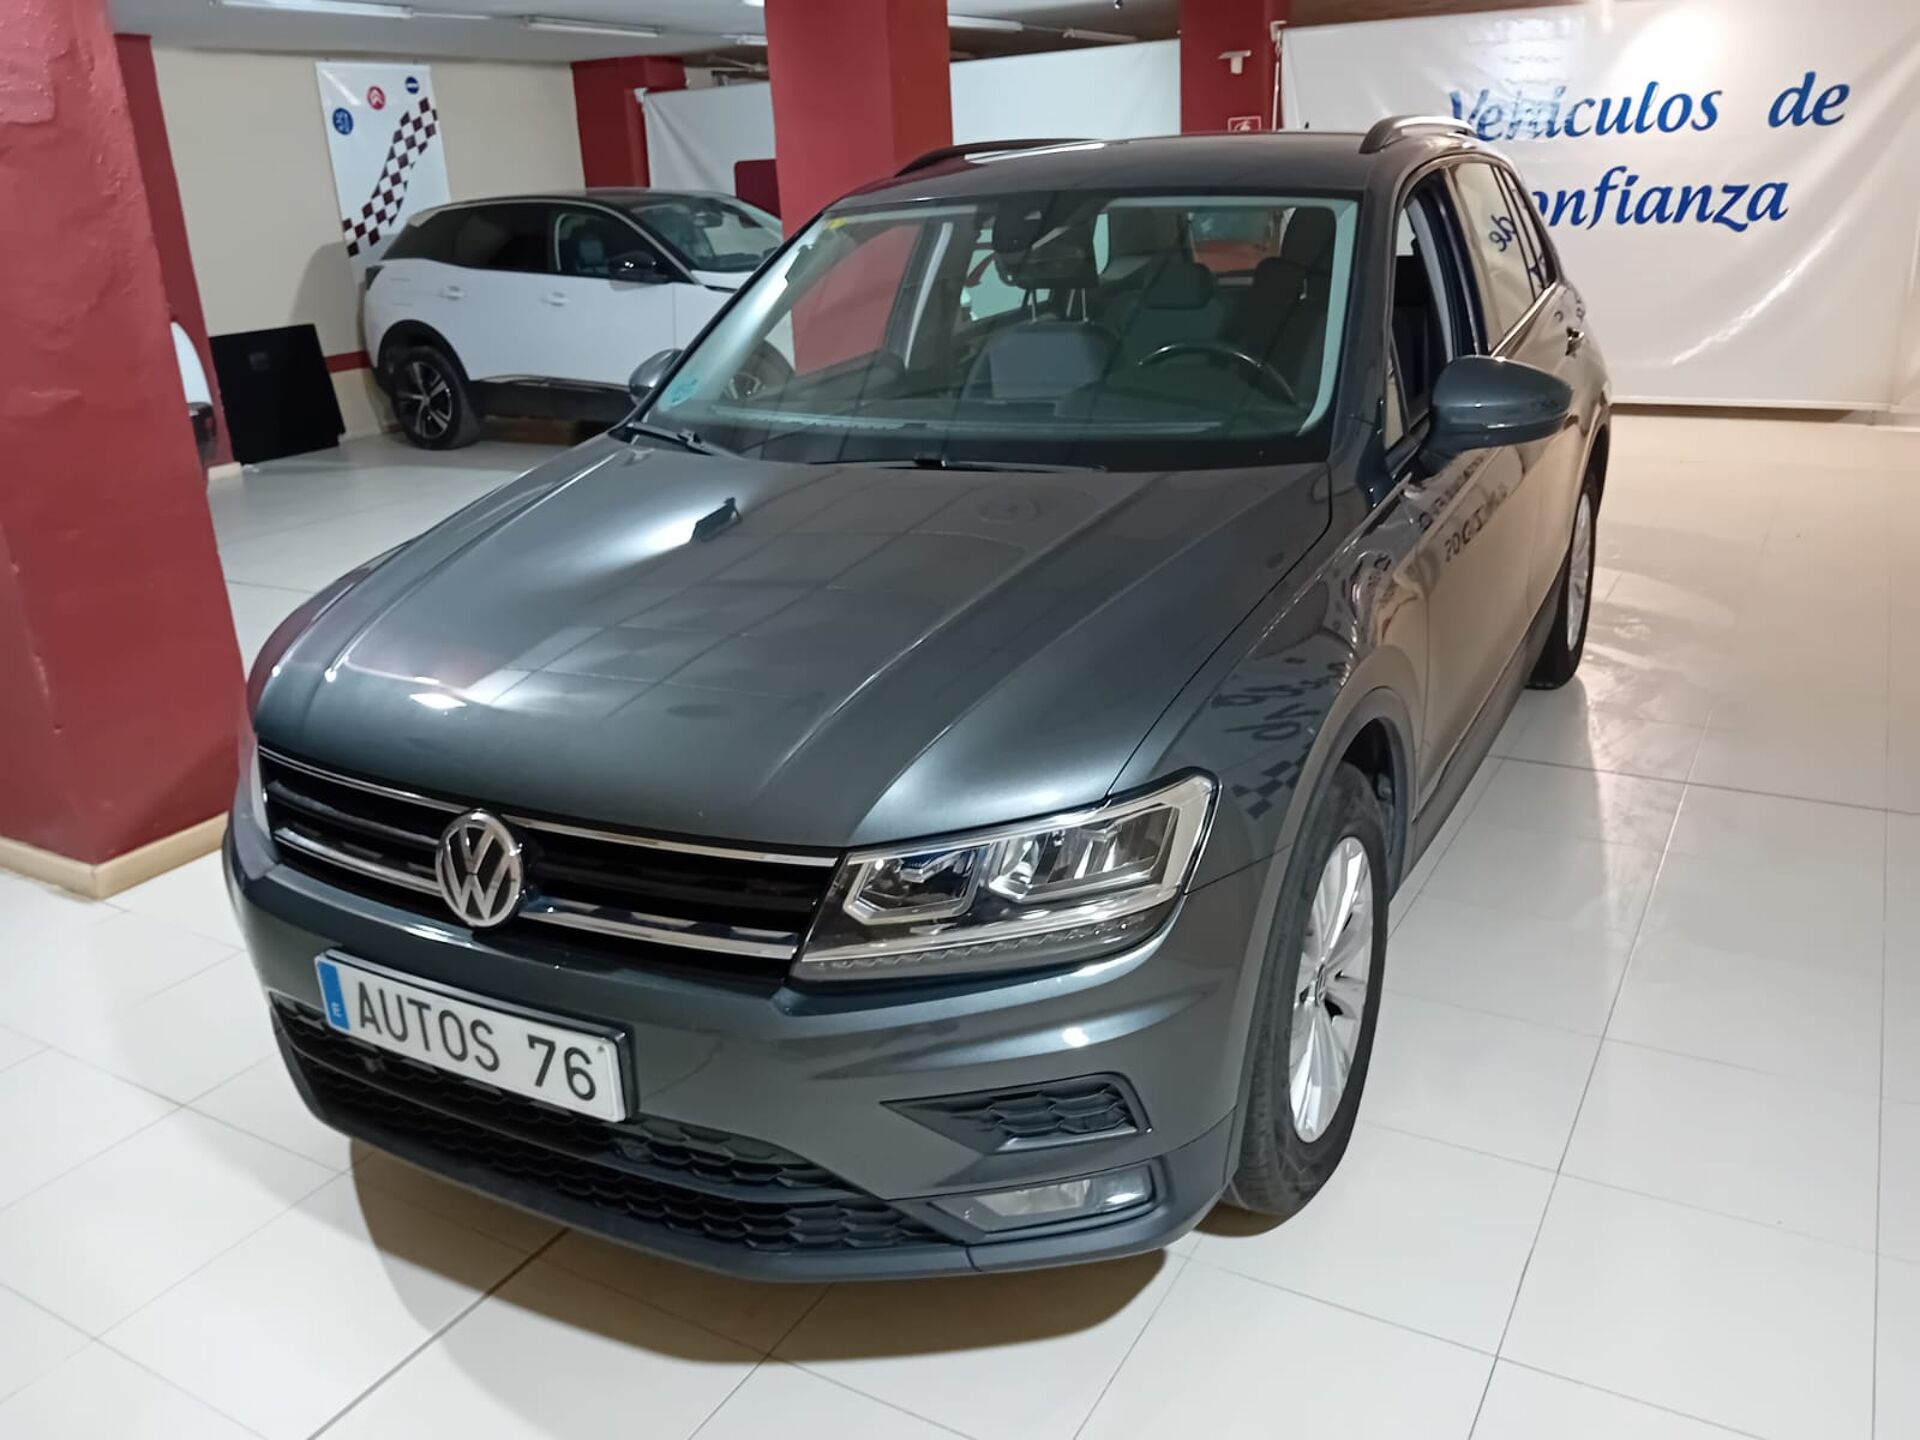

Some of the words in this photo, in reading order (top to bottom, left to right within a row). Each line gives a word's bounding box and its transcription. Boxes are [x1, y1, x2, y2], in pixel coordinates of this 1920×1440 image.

[1767, 70, 1851, 128] de
[356, 980, 501, 1074] AUTOS
[526, 1032, 598, 1102] 76
